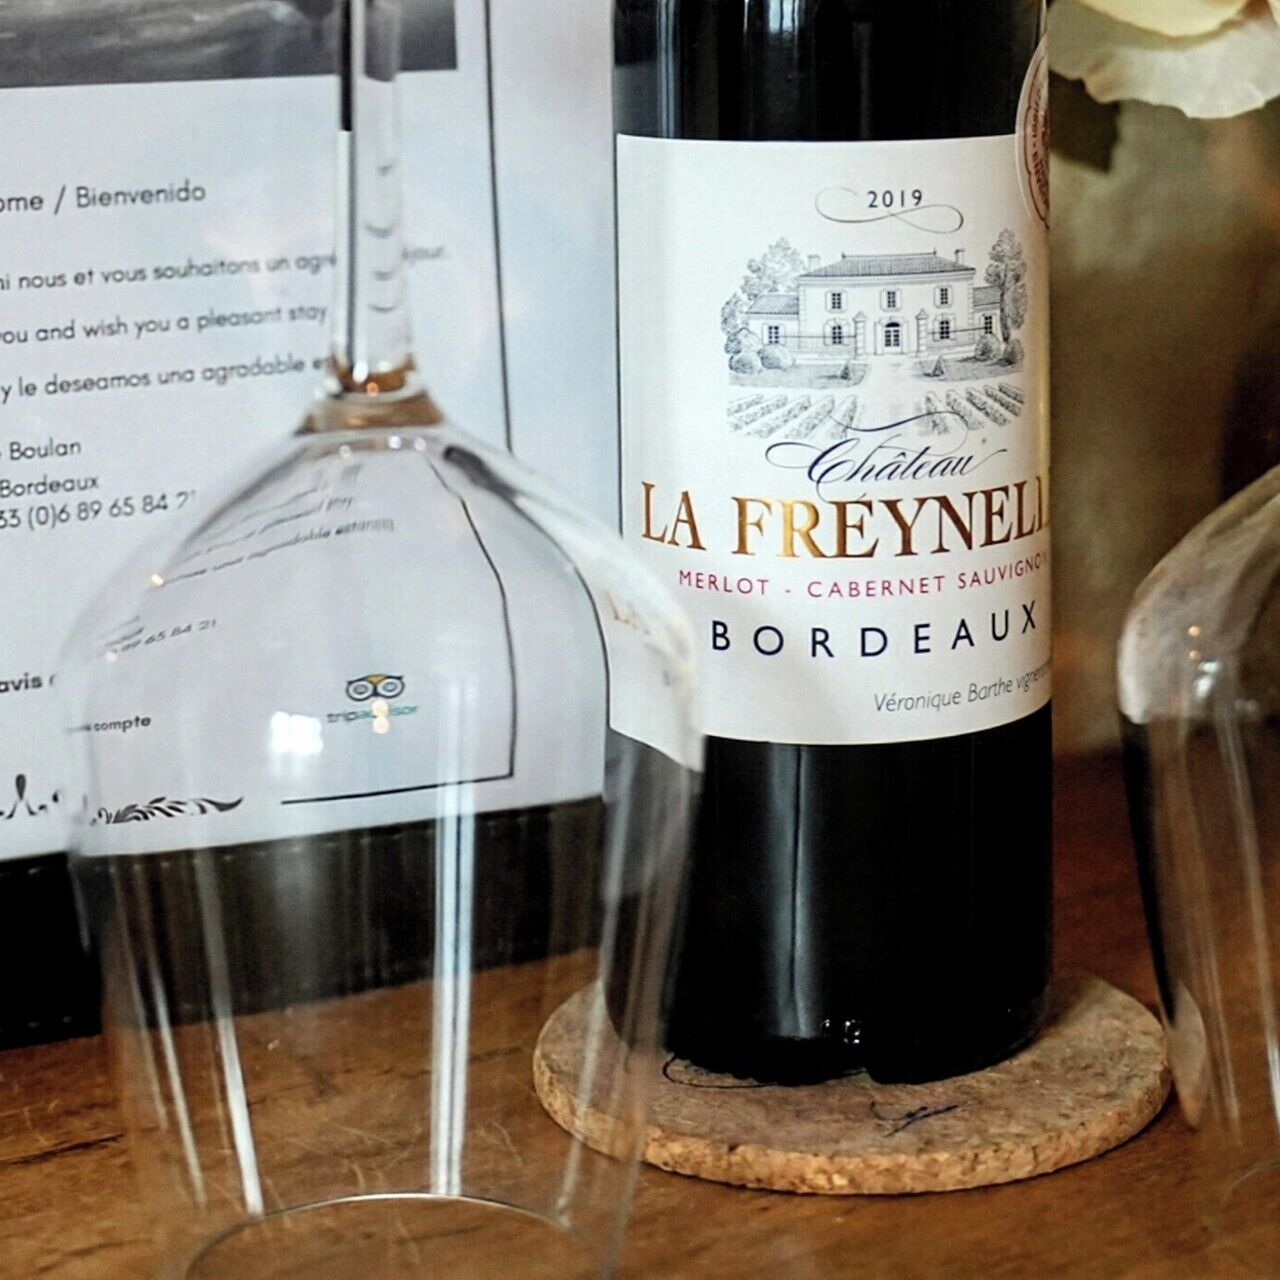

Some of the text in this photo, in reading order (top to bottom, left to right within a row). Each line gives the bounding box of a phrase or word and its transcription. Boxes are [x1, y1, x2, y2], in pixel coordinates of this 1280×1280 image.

[76, 180, 206, 209] Bienvenido
[867, 188, 923, 209] 2019
[19, 271, 67, 290] nous
[74, 269, 94, 287] et
[101, 265, 147, 283] vous
[153, 257, 260, 280] souhaitons
[265, 256, 289, 272] un
[35, 318, 75, 342] and
[83, 317, 127, 339] wish
[134, 318, 170, 340] you
[176, 316, 189, 330] a
[196, 307, 281, 334] pleasant
[1, 383, 12, 405] y
[19, 375, 37, 398] le
[44, 372, 150, 397] deseamos
[158, 368, 195, 386] una
[202, 354, 305, 386] agradable
[10, 437, 81, 462] Boulan
[765, 420, 1008, 490] Château
[0, 474, 100, 500] Bordeaux
[27, 504, 71, 532] (0)6
[77, 500, 103, 522] 89
[109, 496, 135, 518] 65
[142, 493, 168, 514] 84
[641, 480, 705, 553] LA
[679, 569, 769, 596] MERLOT
[807, 575, 945, 599] CABERNET
[712, 600, 1036, 658] BORDEAUX
[873, 683, 961, 713] Véronique
[968, 675, 1013, 703] Barthe
[93, 715, 152, 733] compte
